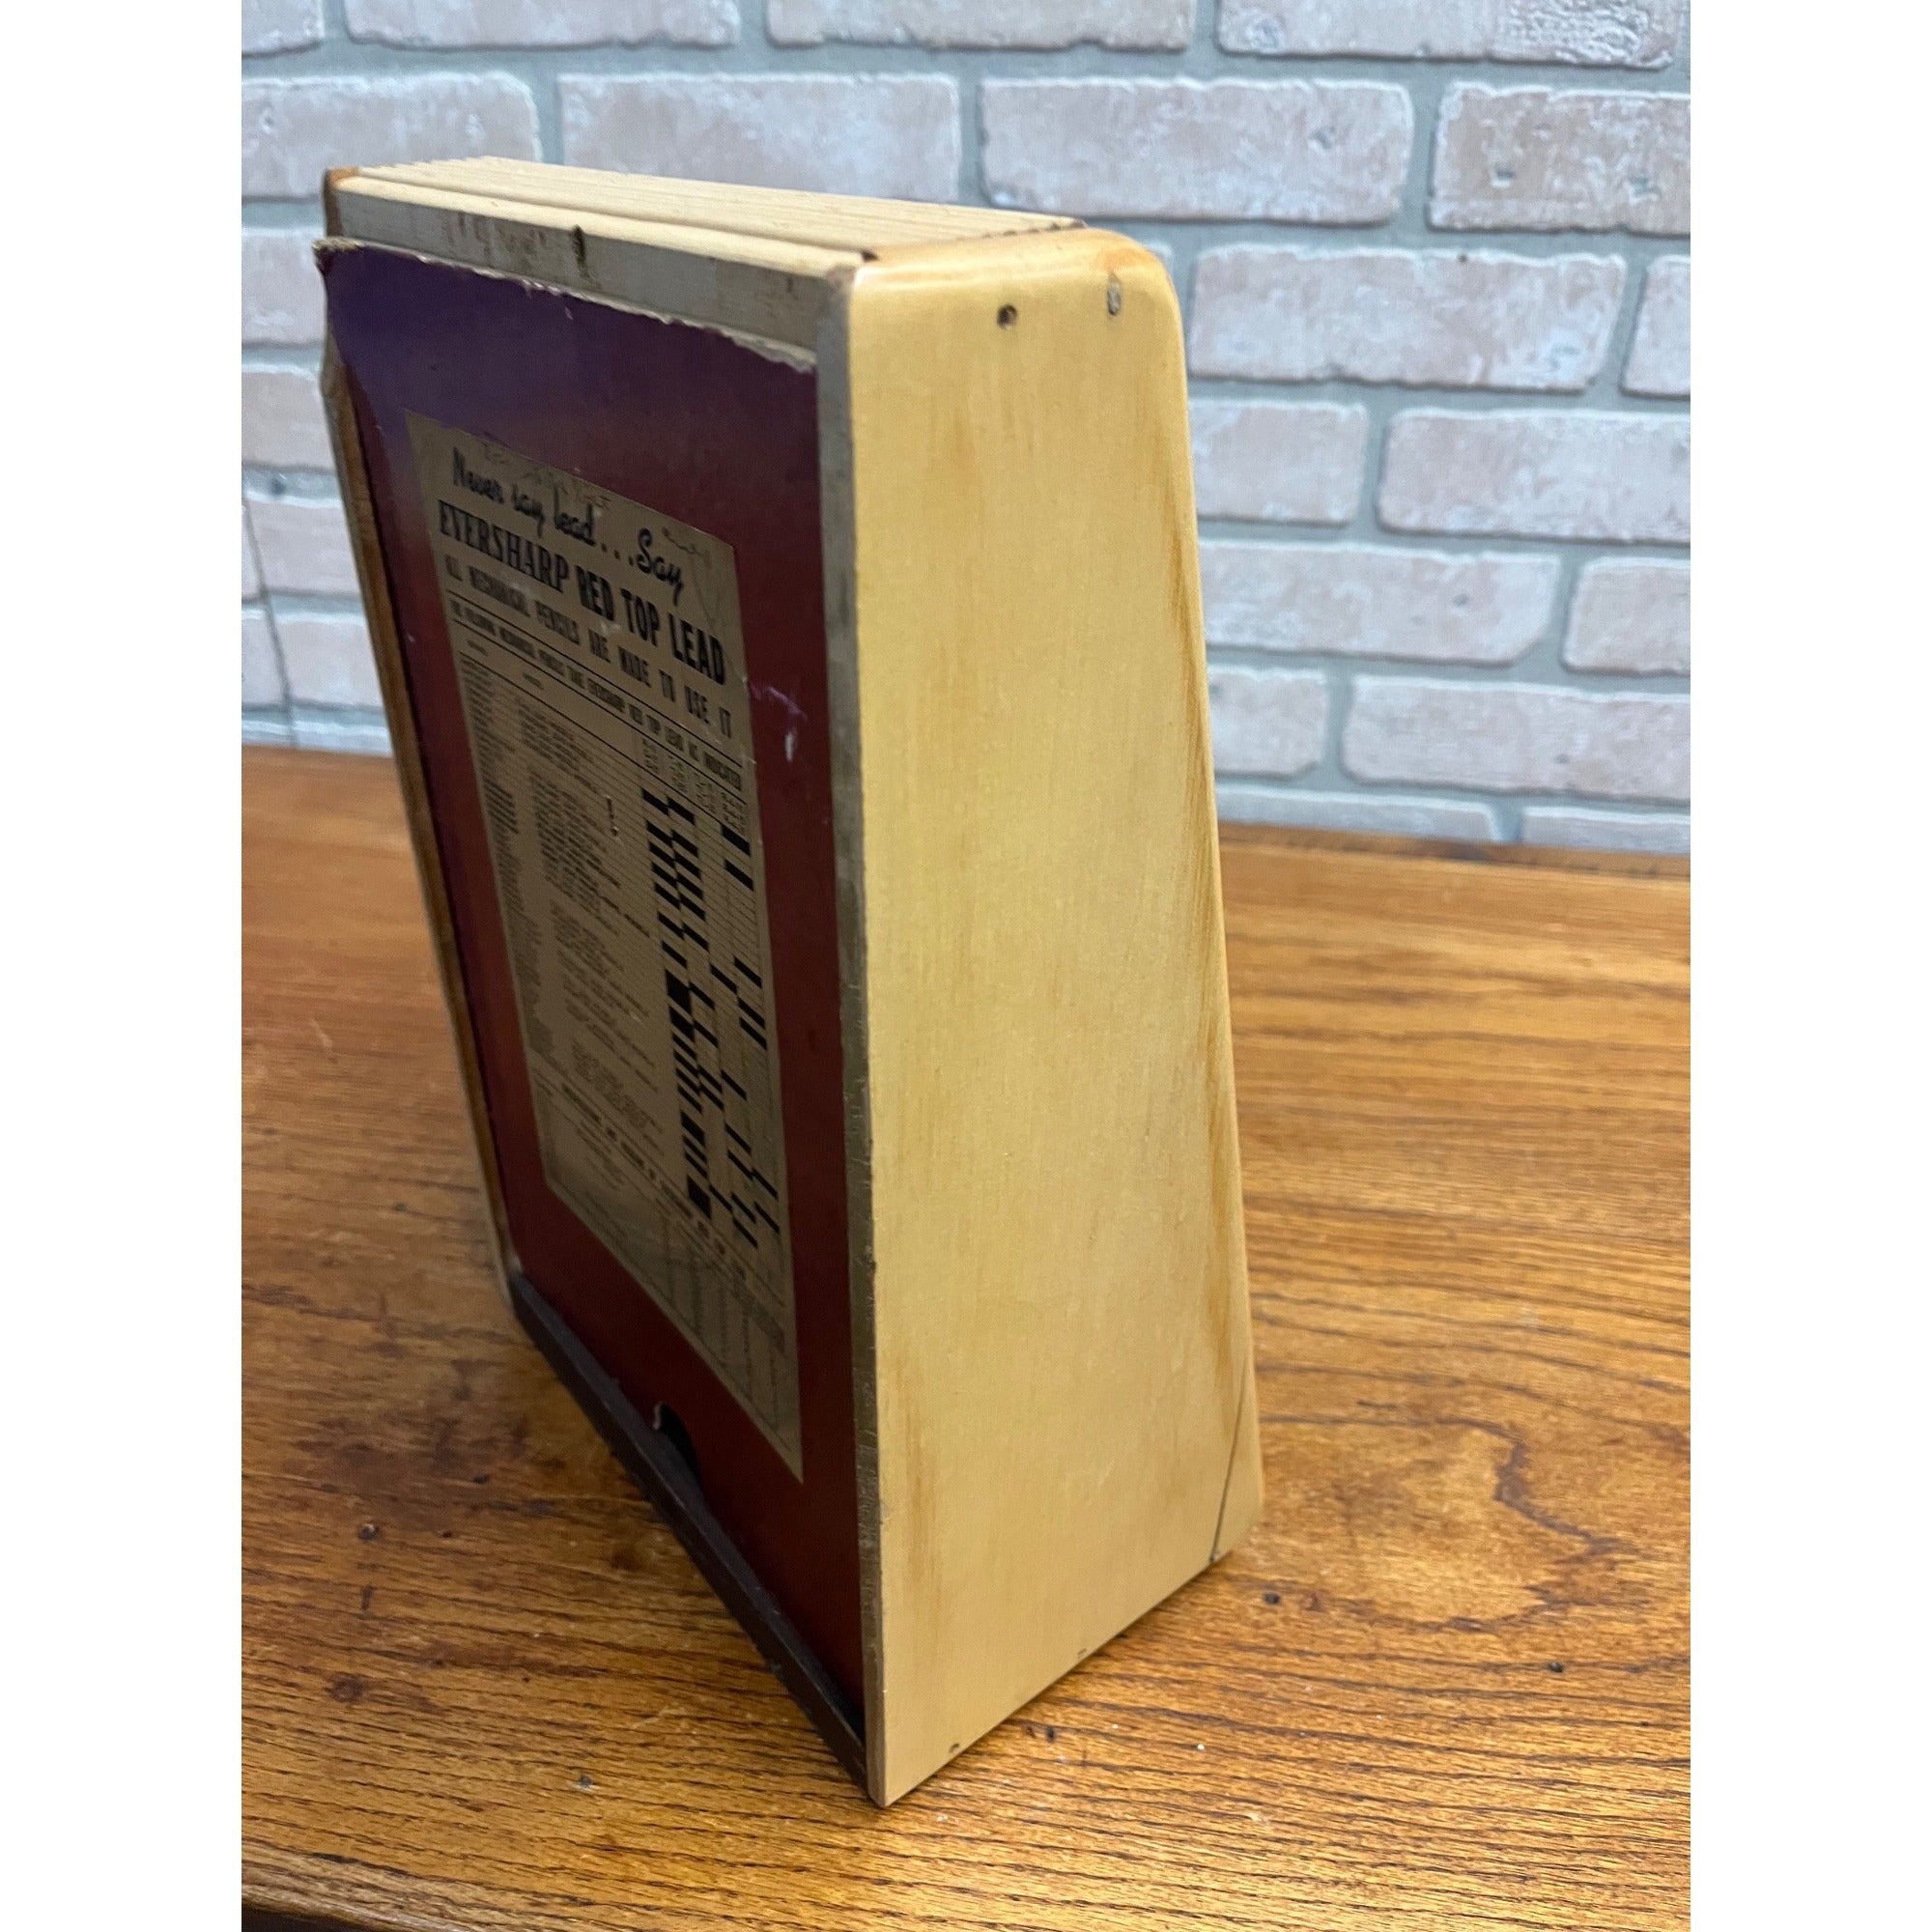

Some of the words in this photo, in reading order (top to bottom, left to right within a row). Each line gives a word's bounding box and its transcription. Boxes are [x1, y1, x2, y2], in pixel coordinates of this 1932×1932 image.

[438, 498, 569, 593] EVERSHARP
[575, 565, 615, 621] RED
[619, 587, 661, 647] TOP
[668, 612, 726, 686] LEAD
[453, 446, 504, 504] Never
[510, 482, 546, 539] say
[635, 527, 684, 607] Say
[534, 599, 581, 646] PENCILS
[588, 629, 611, 664] ARE
[617, 644, 651, 688] MADE
[658, 668, 675, 702] TO
[684, 685, 710, 725] USE
[719, 706, 732, 740] IT
